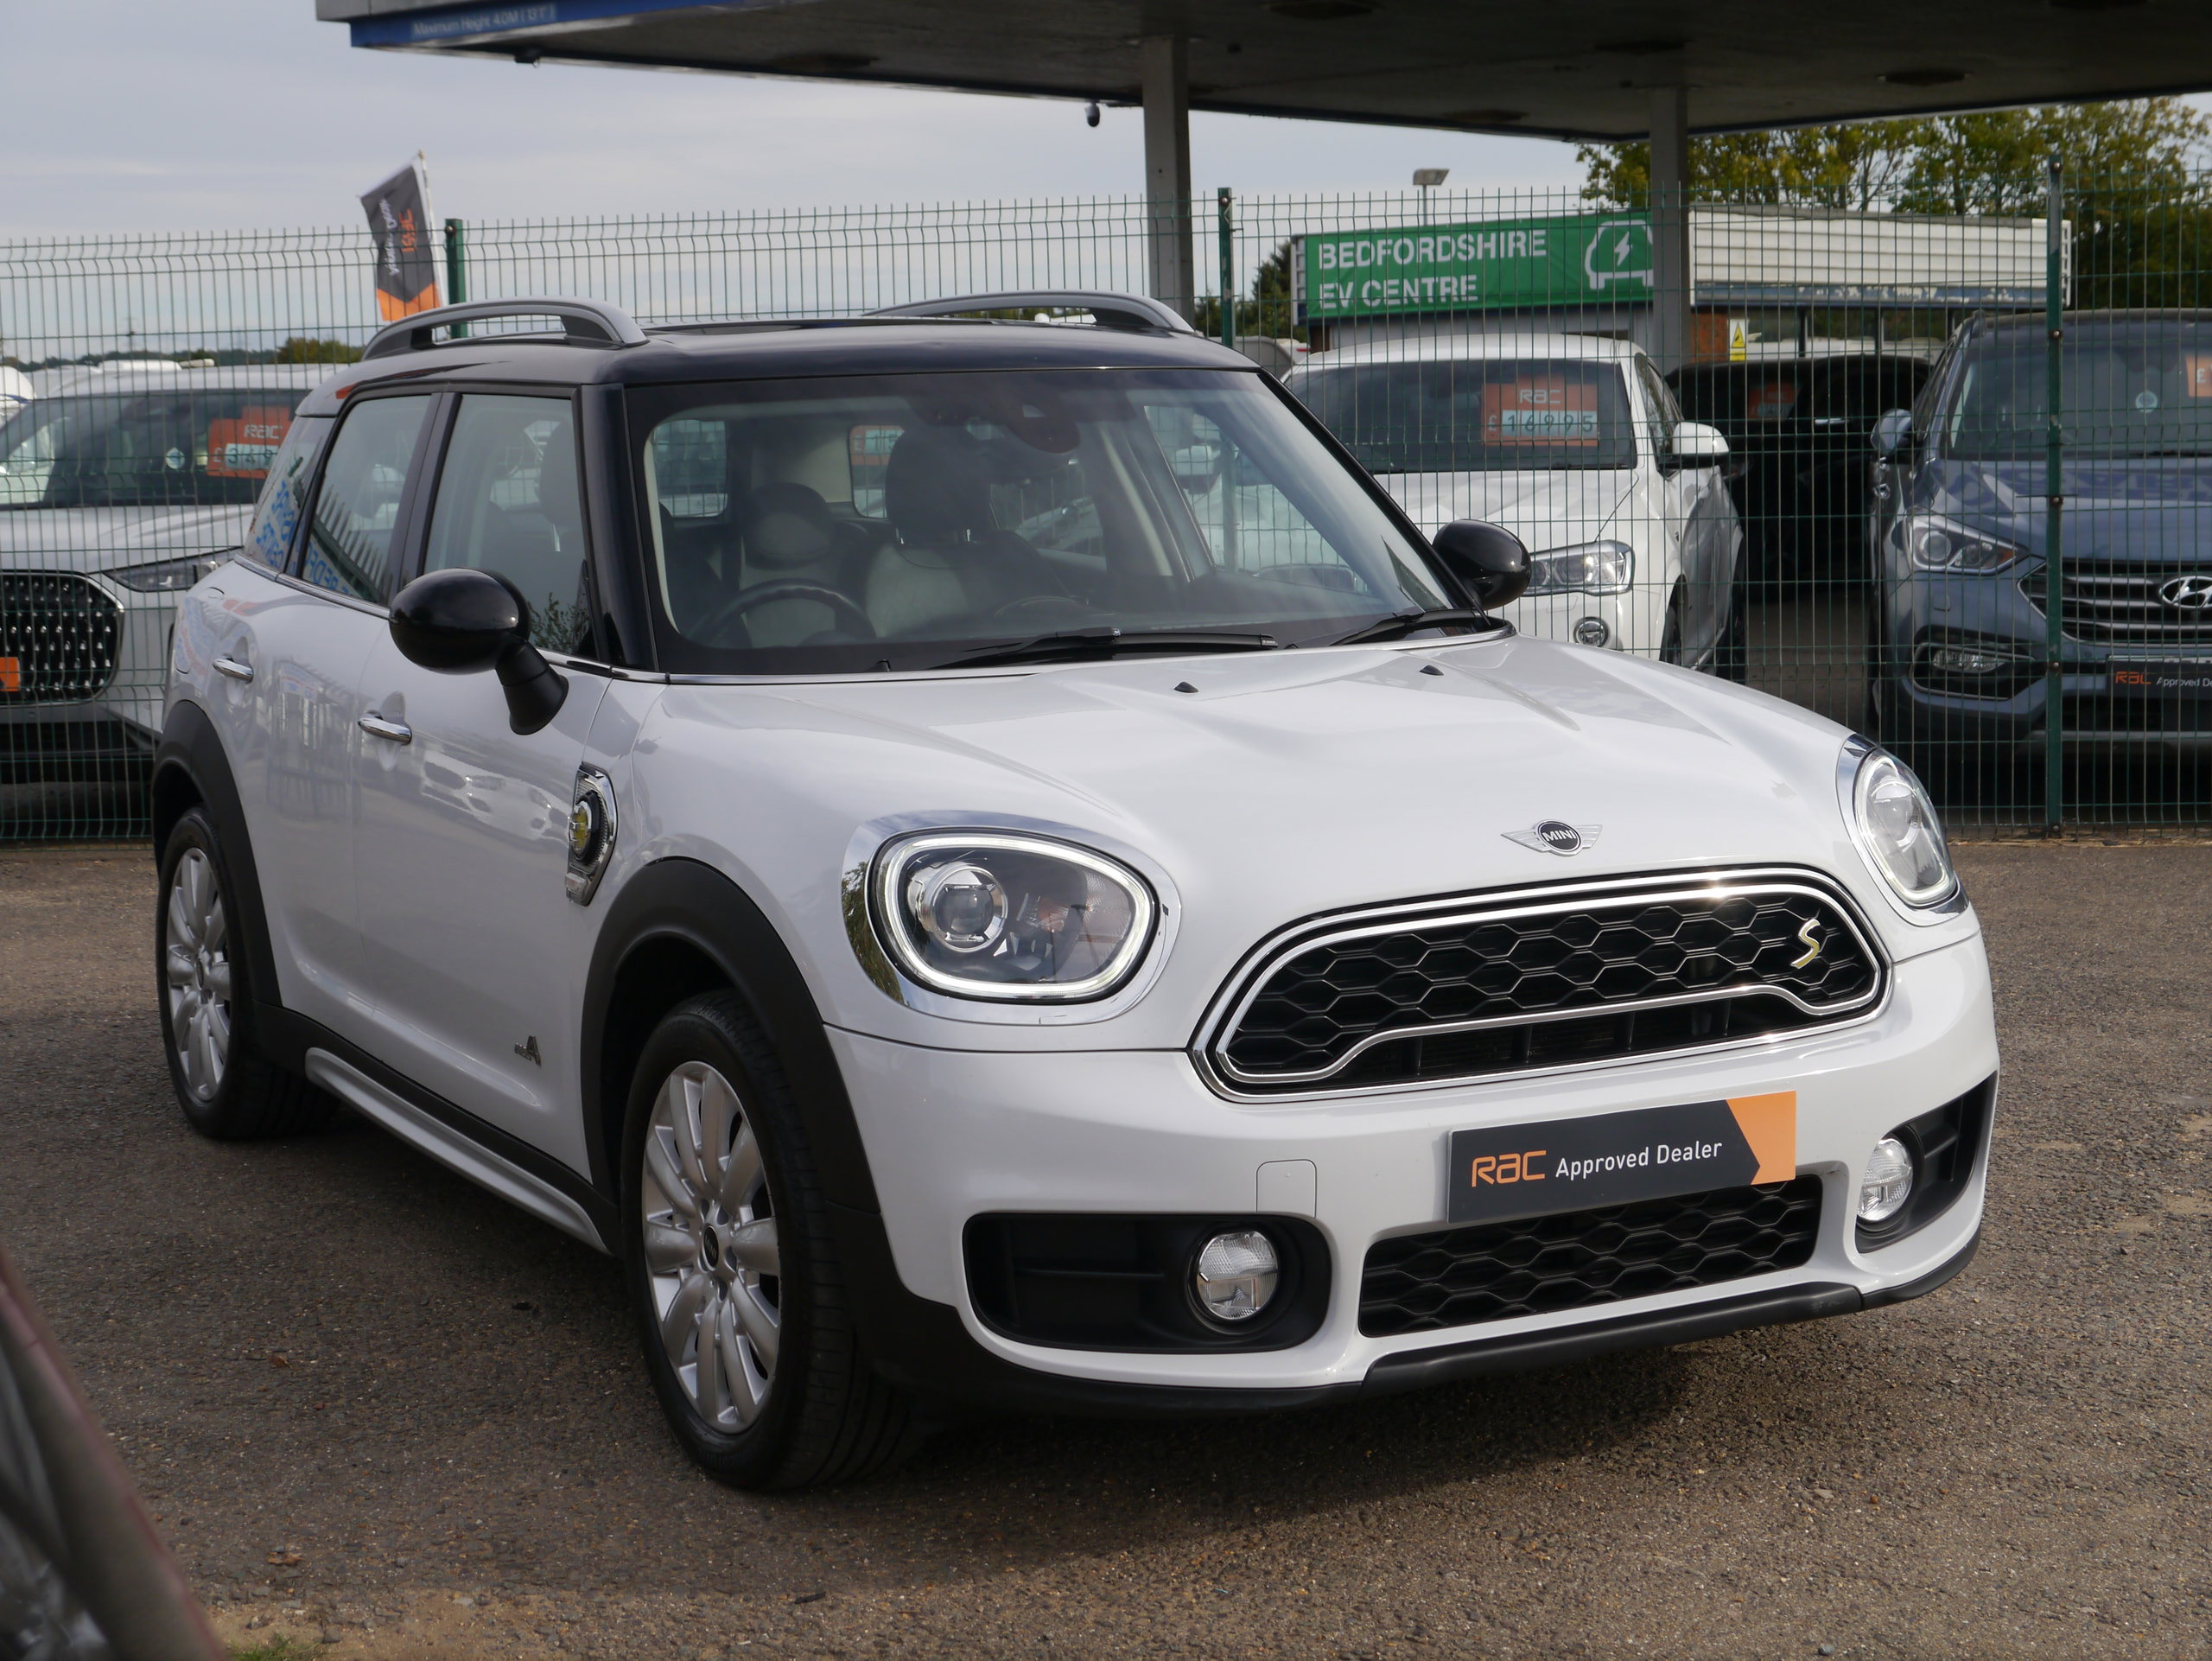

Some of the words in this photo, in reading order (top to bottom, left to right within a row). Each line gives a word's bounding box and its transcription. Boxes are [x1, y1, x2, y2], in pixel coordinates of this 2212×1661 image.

[1319, 229, 1547, 270] BEDFORDSHIRE
[1319, 282, 1353, 309] EV
[1361, 275, 1478, 305] CENTRE
[2157, 677, 2199, 688] Approved
[1541, 830, 1577, 842] MINI
[1789, 919, 1821, 970] S
[1556, 1147, 1649, 1181] Approved
[1656, 1141, 1723, 1165] Dealer
